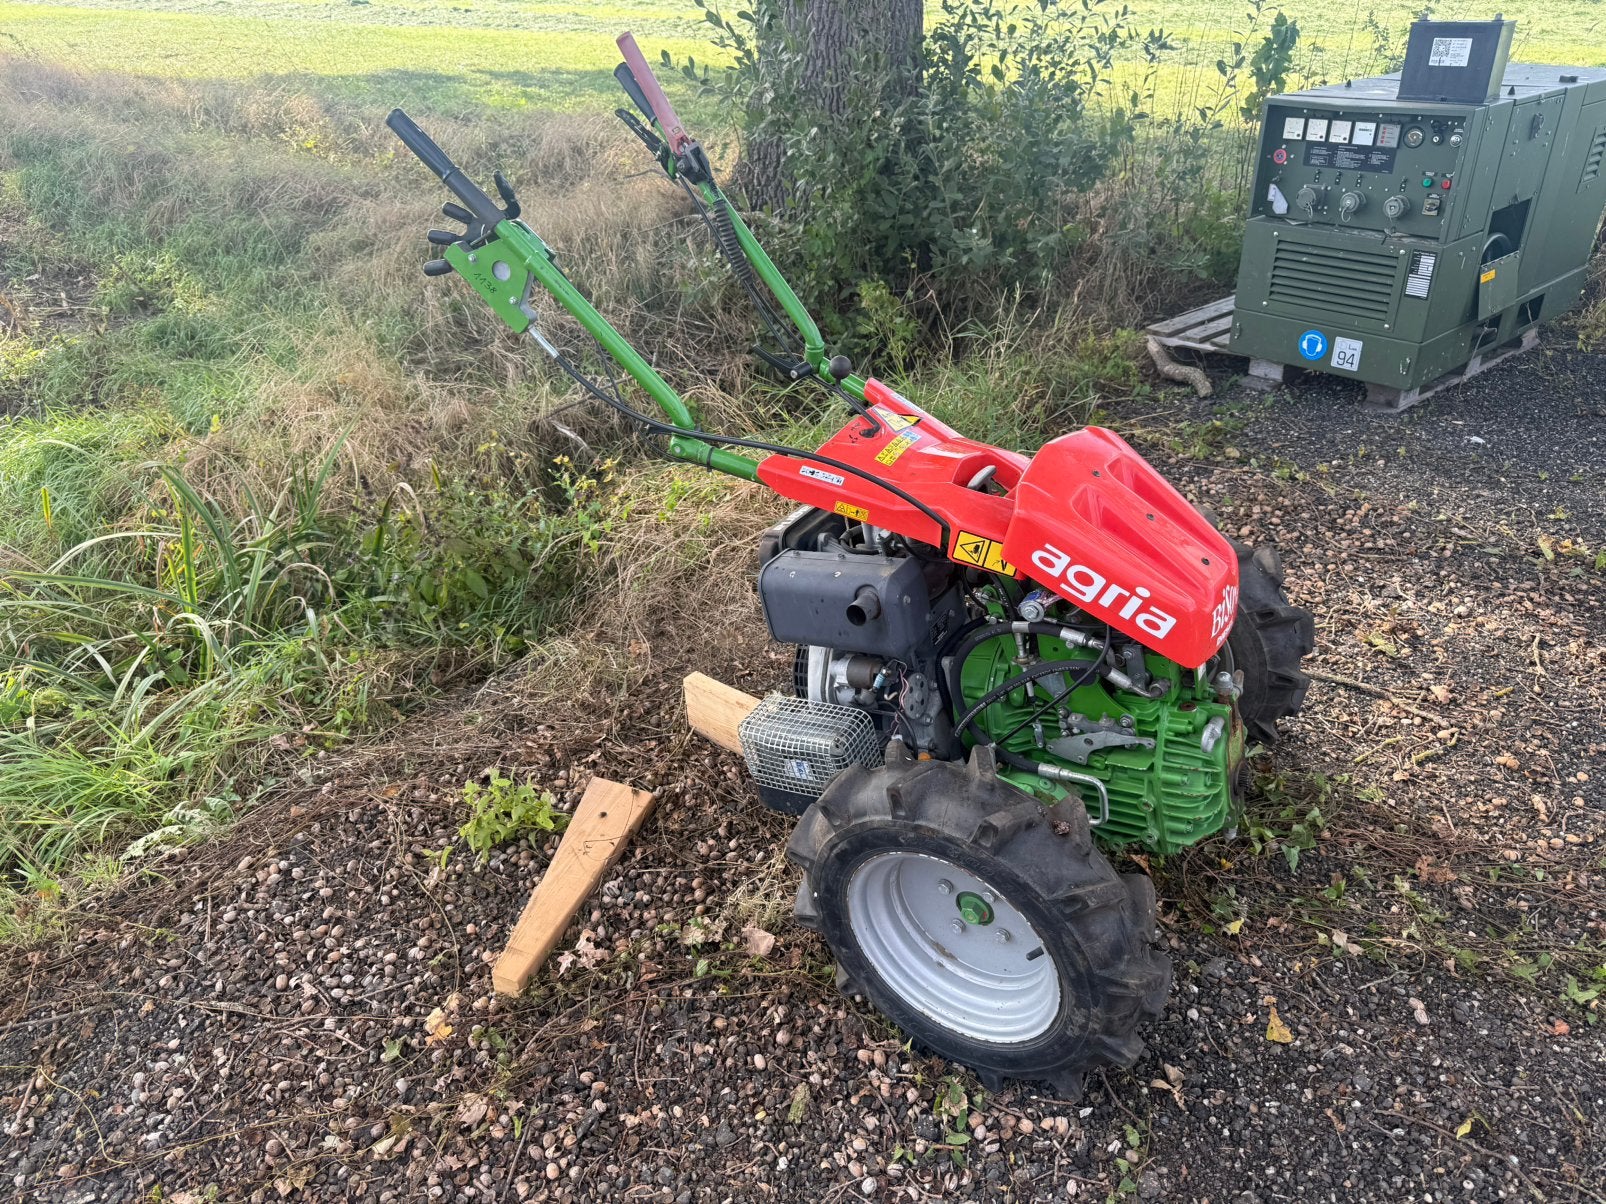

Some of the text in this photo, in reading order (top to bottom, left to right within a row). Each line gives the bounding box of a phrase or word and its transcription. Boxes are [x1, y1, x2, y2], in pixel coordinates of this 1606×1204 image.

[473, 273, 497, 294] 1138
[1336, 350, 1356, 368] 94
[1031, 543, 1177, 640] agria
